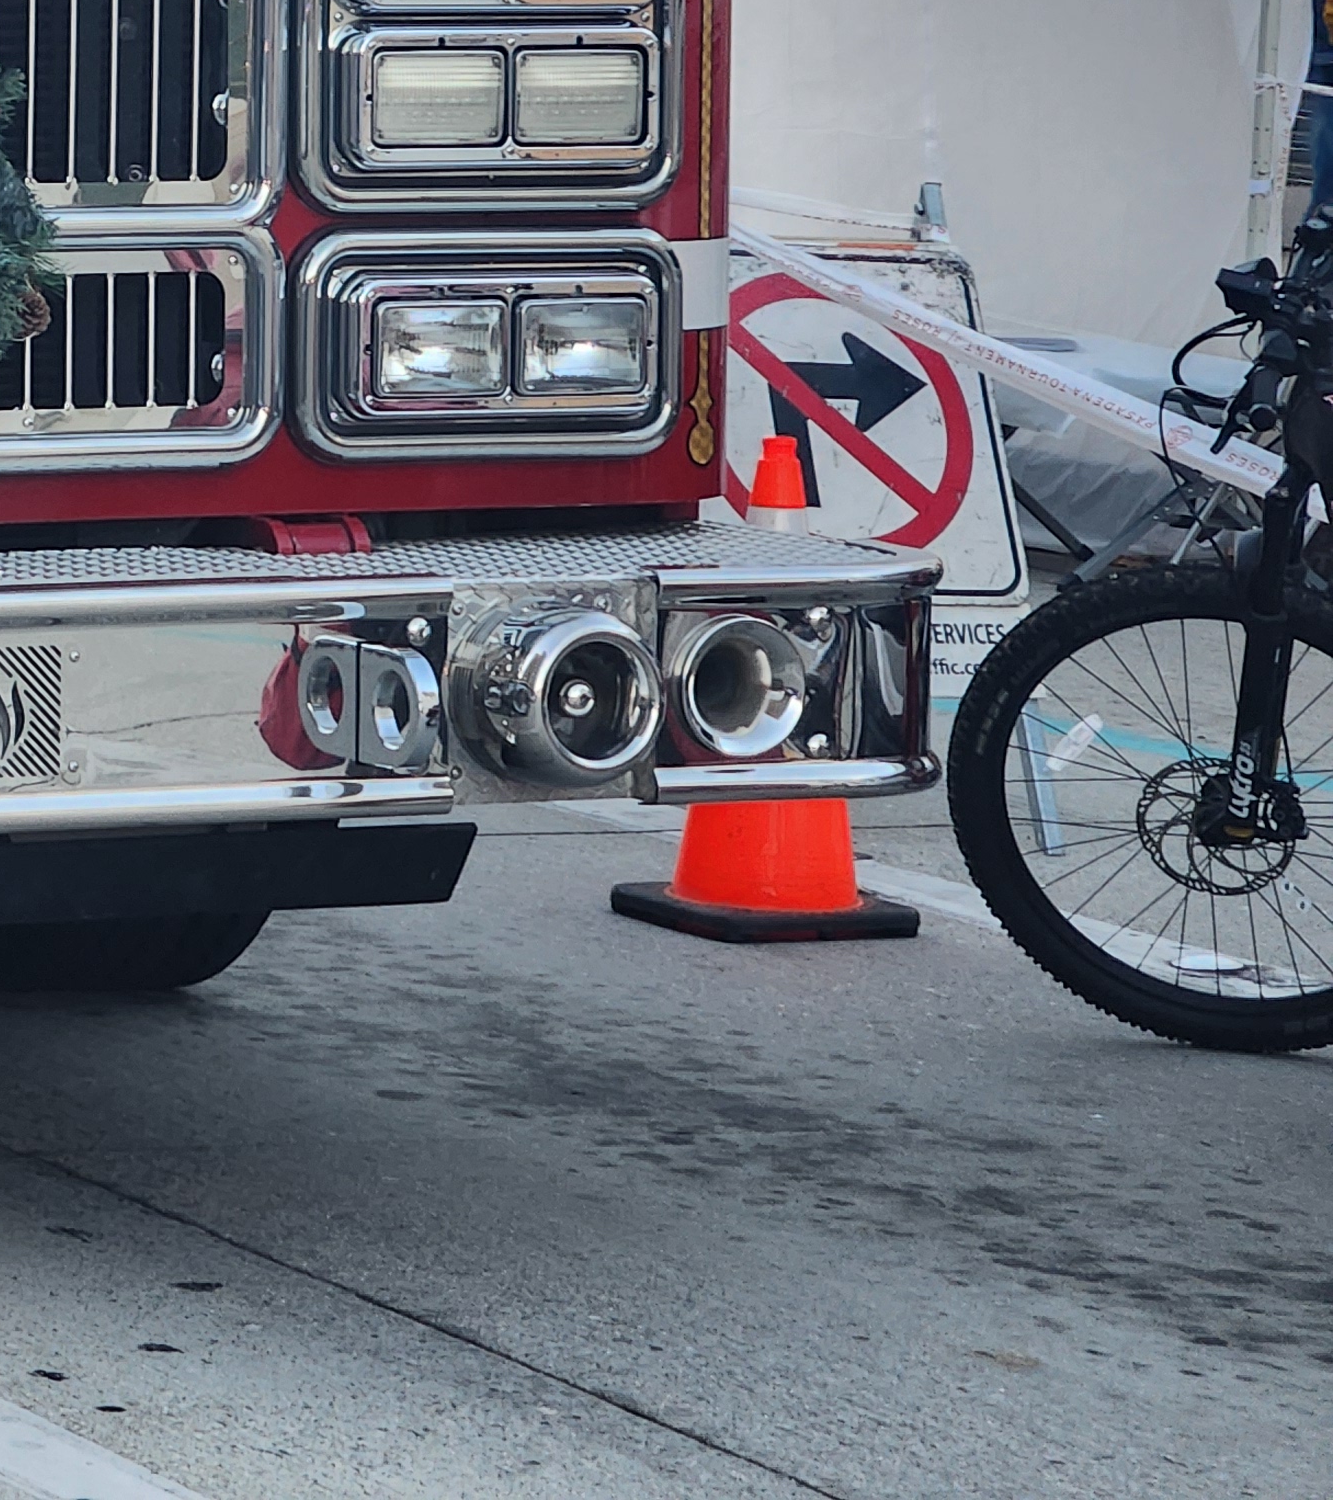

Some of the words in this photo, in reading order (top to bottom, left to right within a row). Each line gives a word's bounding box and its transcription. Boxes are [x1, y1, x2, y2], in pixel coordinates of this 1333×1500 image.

[892, 308, 943, 337] ROSES
[964, 341, 1069, 393] TOURNAMENT
[1072, 385, 1158, 430] PASADENA
[930, 622, 1007, 645] ERVICES
